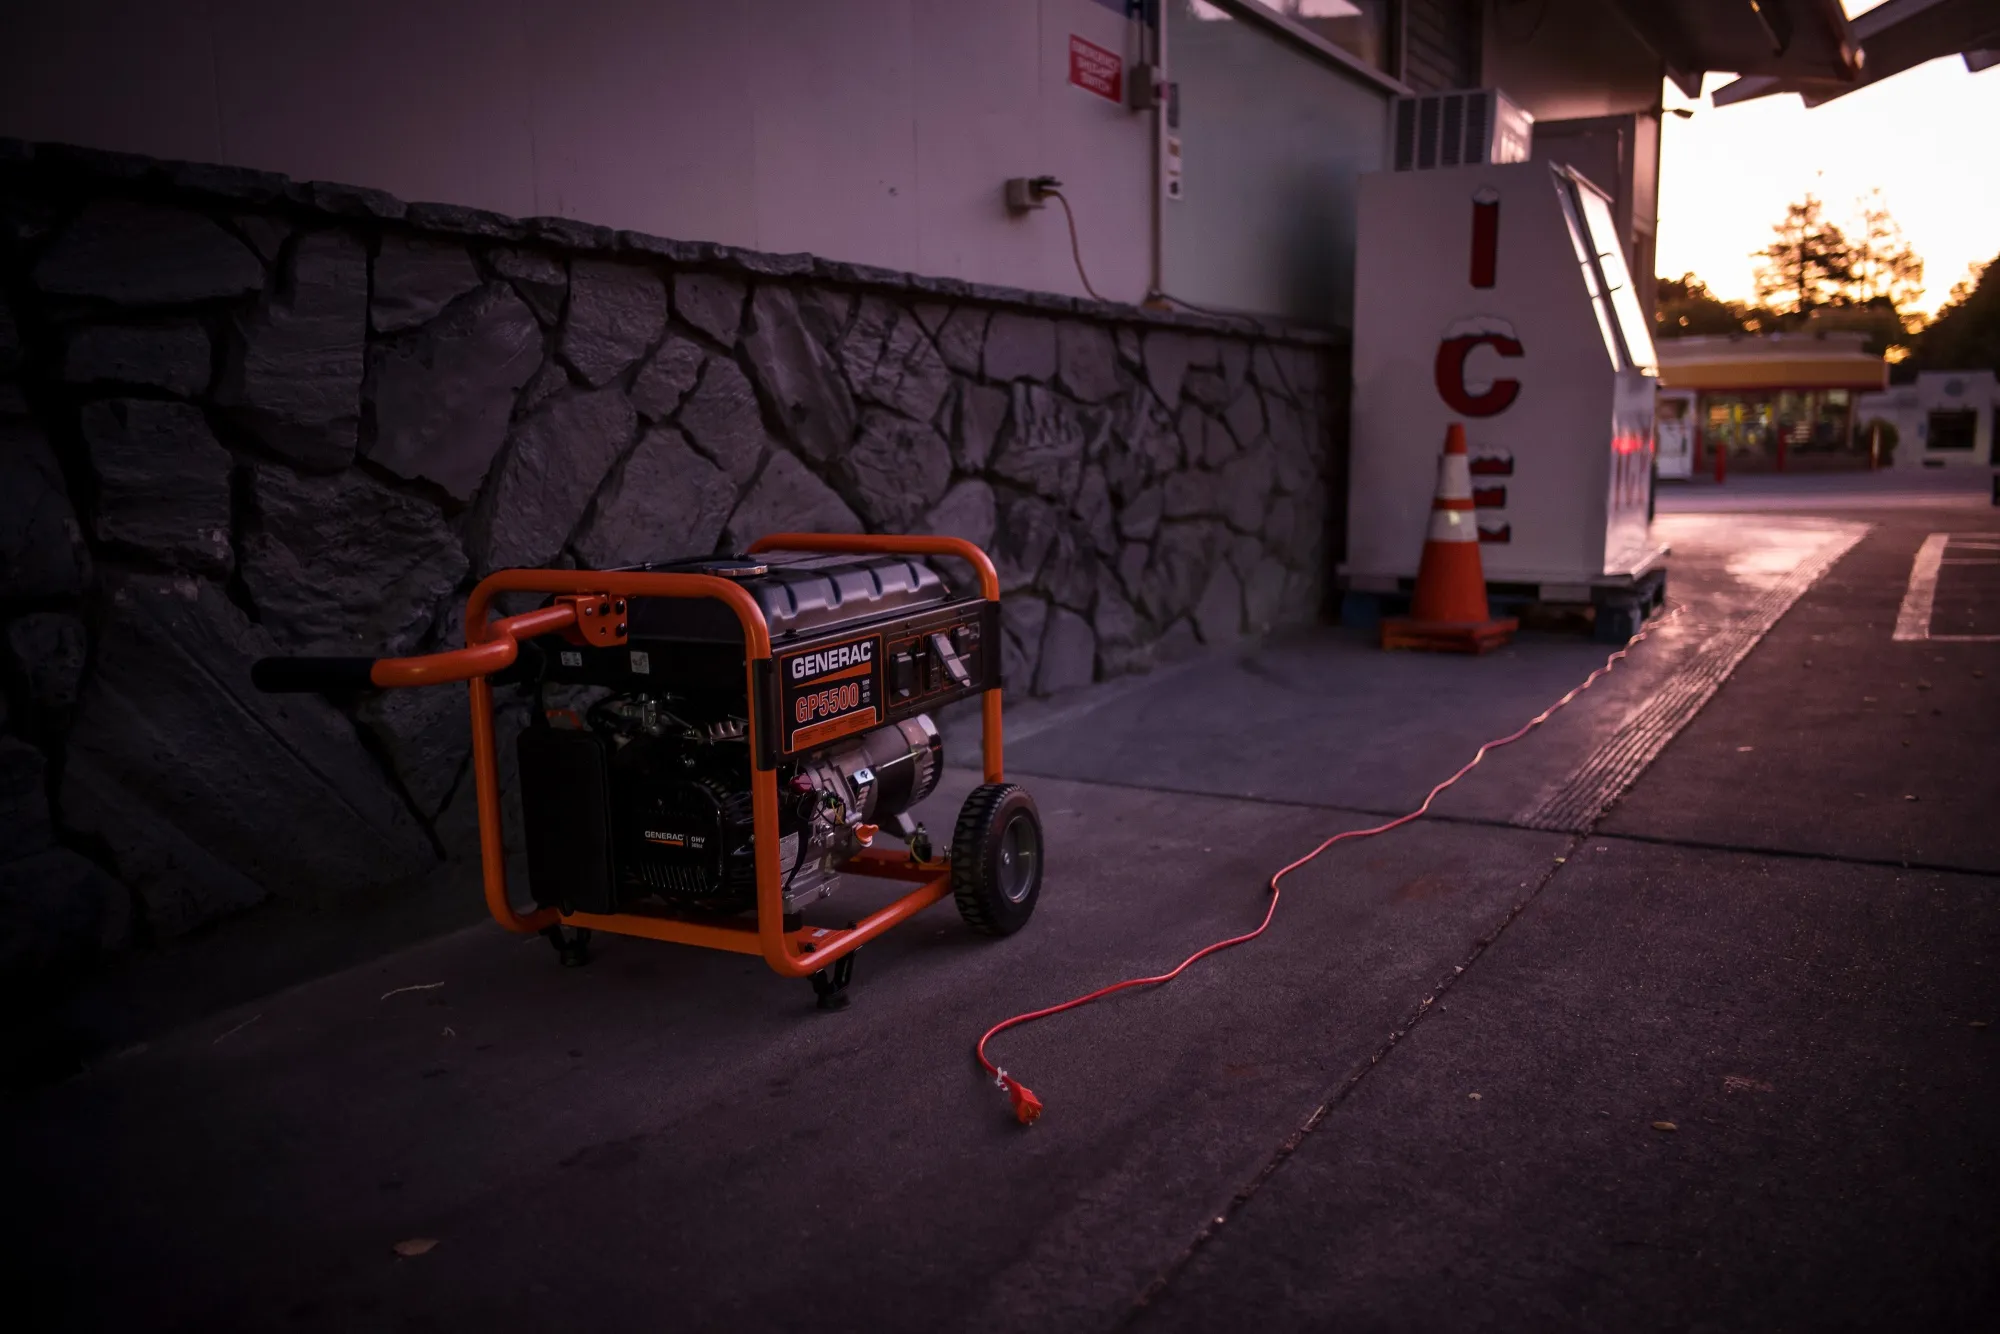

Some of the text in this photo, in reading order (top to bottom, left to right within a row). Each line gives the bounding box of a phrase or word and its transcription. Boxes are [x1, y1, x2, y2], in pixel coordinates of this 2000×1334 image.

[792, 641, 872, 679] GENERAC
[796, 682, 859, 723] GP5500
[645, 831, 684, 841] GENERAC
